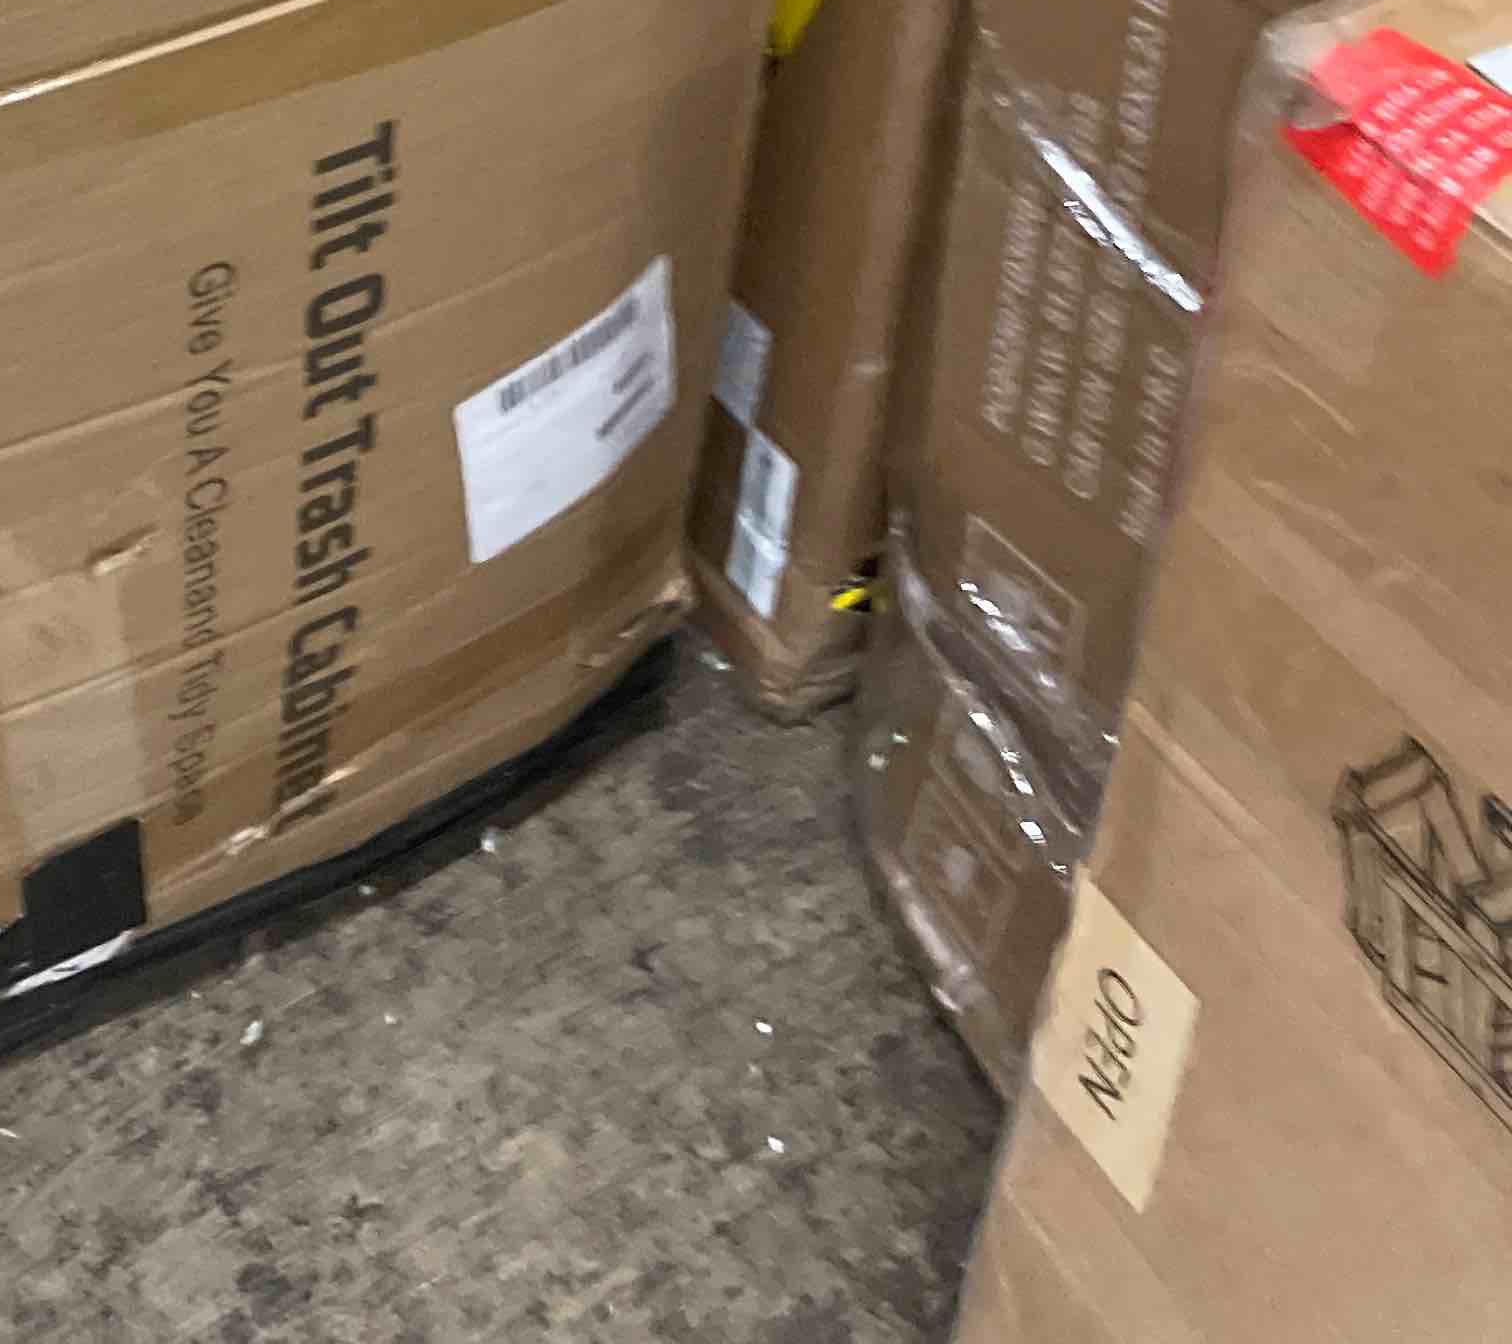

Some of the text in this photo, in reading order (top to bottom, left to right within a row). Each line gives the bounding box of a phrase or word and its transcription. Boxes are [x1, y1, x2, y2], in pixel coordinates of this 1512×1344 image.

[310, 119, 395, 272] Tilt
[187, 261, 236, 355] Give
[302, 272, 383, 422] Out
[186, 358, 236, 440] You
[186, 445, 231, 476] A
[294, 413, 377, 606] Trash
[1077, 968, 1144, 1121] OPEN
